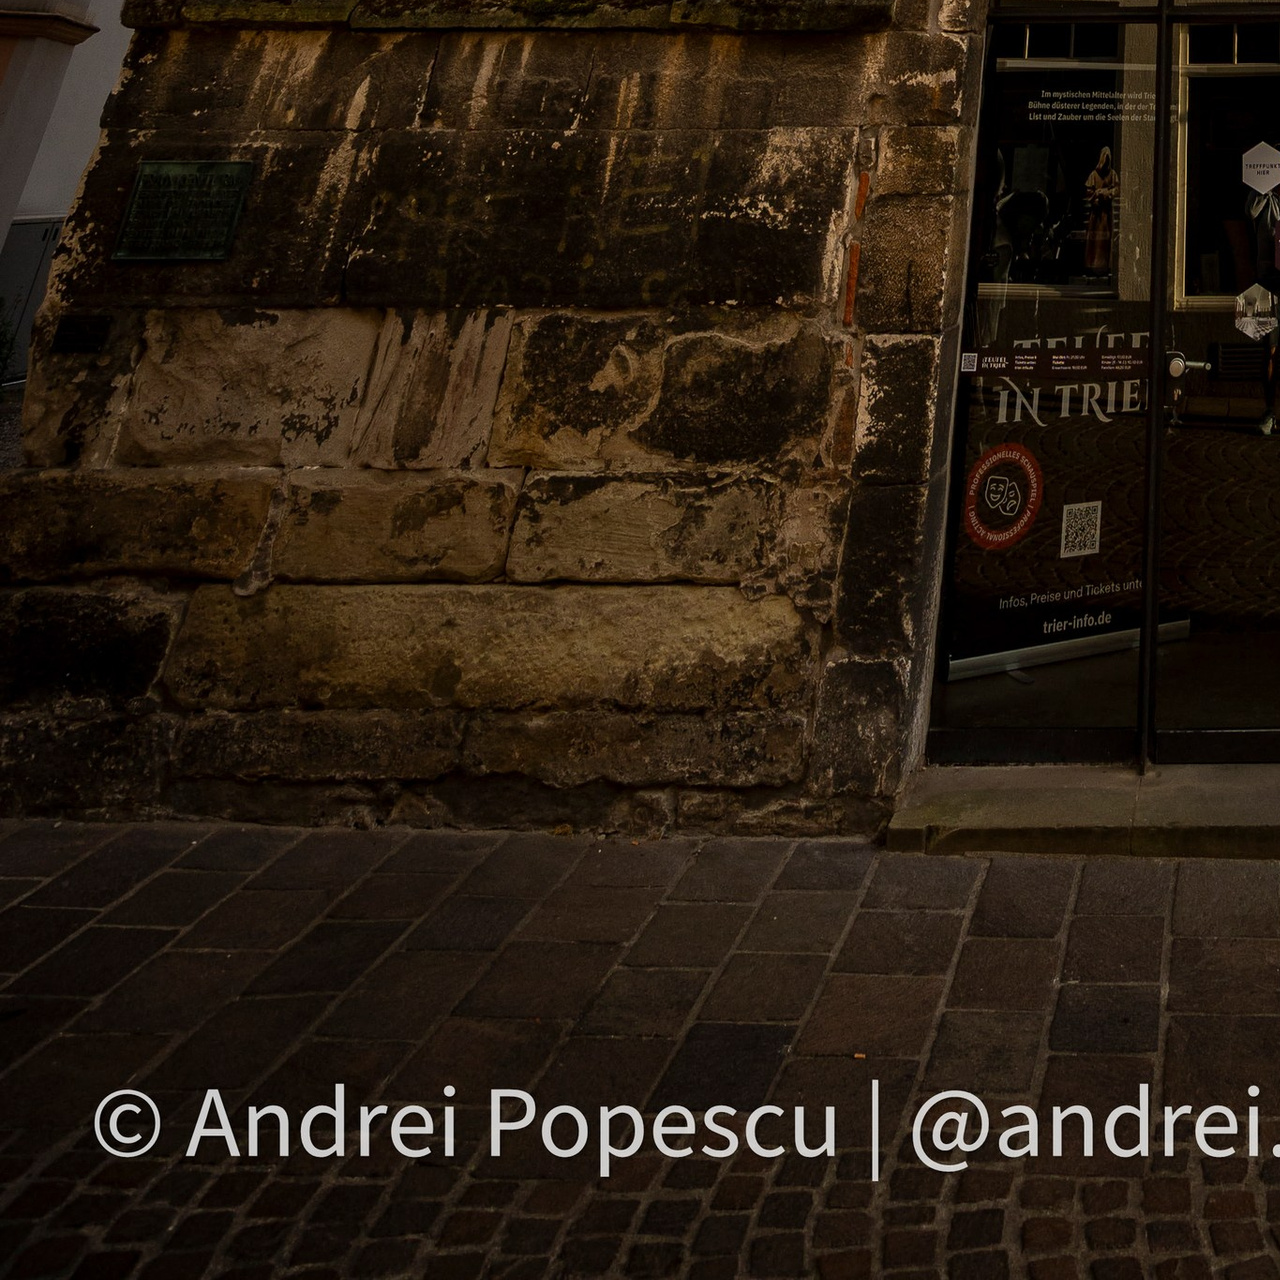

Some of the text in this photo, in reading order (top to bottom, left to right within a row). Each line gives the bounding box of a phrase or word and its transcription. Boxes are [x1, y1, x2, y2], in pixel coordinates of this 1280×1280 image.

[1028, 100, 1050, 109] Bühne
[1051, 101, 1080, 110] düsterer
[1125, 102, 1136, 110] der
[1041, 90, 1051, 98] Im
[1052, 90, 1090, 100] mystischen
[1092, 91, 1126, 99] Mittelalter
[1127, 91, 1142, 99] wird
[1029, 112, 1042, 121] List
[1043, 112, 1057, 121] und
[1057, 112, 1082, 121] Zauber
[1095, 112, 1106, 121] die
[1130, 113, 1142, 121] der
[995, 376, 1150, 427] IN TRIE
[969, 450, 1021, 496] PROFESSIONELLES
[1020, 455, 1038, 502] SCHAUSPIEL
[969, 510, 987, 536] ACTING
[986, 509, 1031, 541] PROFESSIONAL
[999, 595, 1028, 610] Infos,
[1030, 590, 1061, 605] Preise
[1063, 586, 1083, 600] und
[1085, 581, 1121, 596] Tickets
[1043, 610, 1112, 634] trier-info.de
